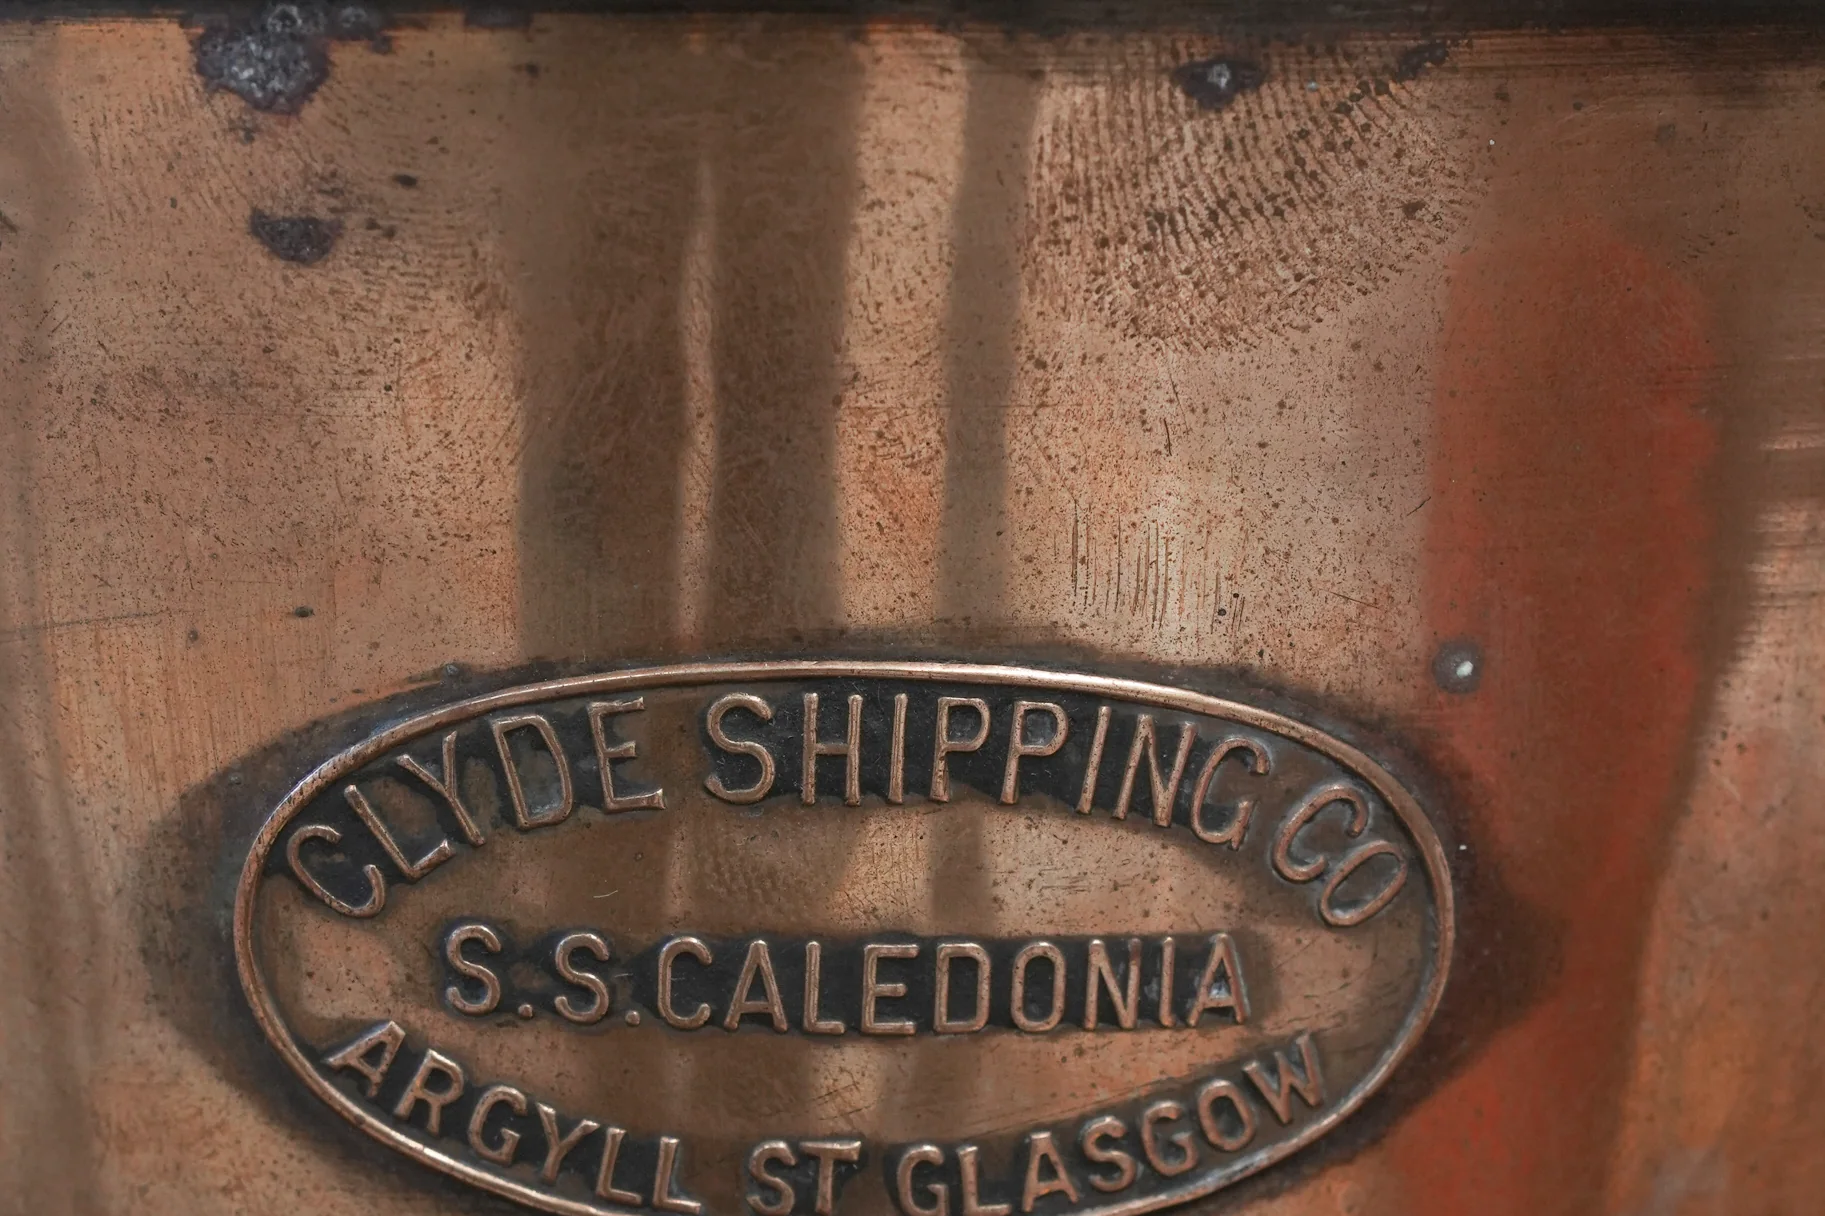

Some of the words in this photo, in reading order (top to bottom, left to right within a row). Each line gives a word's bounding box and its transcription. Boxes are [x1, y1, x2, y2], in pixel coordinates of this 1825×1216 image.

[286, 696, 667, 918] CLYDE
[705, 692, 1270, 850] SHIPPING
[1272, 784, 1407, 926] CO
[324, 1021, 701, 1214] ARGYLL
